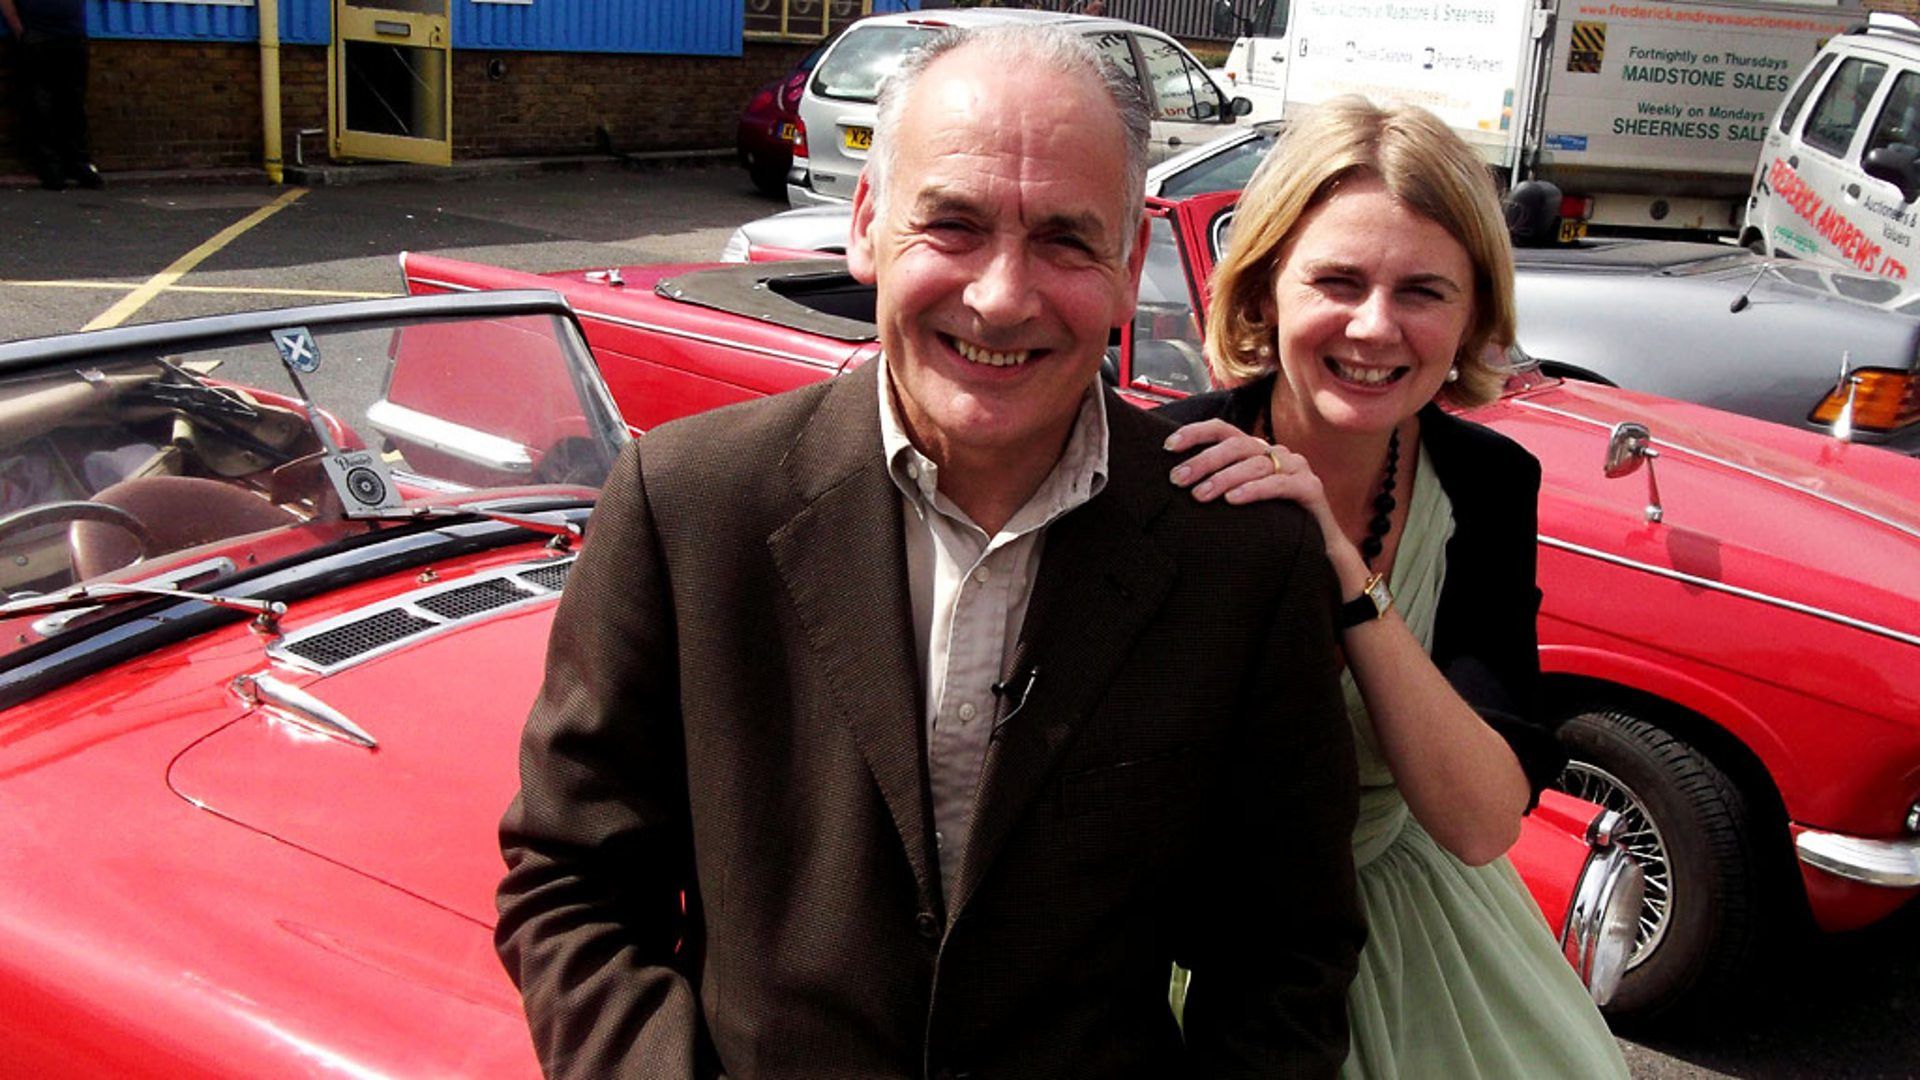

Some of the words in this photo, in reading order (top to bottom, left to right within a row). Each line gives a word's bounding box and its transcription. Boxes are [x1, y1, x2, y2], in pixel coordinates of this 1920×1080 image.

[1443, 4, 1496, 25] Sheerness
[1629, 46, 1698, 65] Fortnightly
[1703, 53, 1719, 63] on
[1725, 52, 1788, 70] Thursdays
[1622, 65, 1726, 88] MAIDSTONE
[1733, 73, 1789, 93] SALES
[1637, 102, 1683, 119] Weekly
[1688, 108, 1704, 118] on
[1709, 107, 1766, 122] Mondays
[1612, 118, 1720, 140] SHEERNESS
[1768, 156, 1824, 227] FREDERICK
[1817, 205, 1882, 273] ANDREWS
